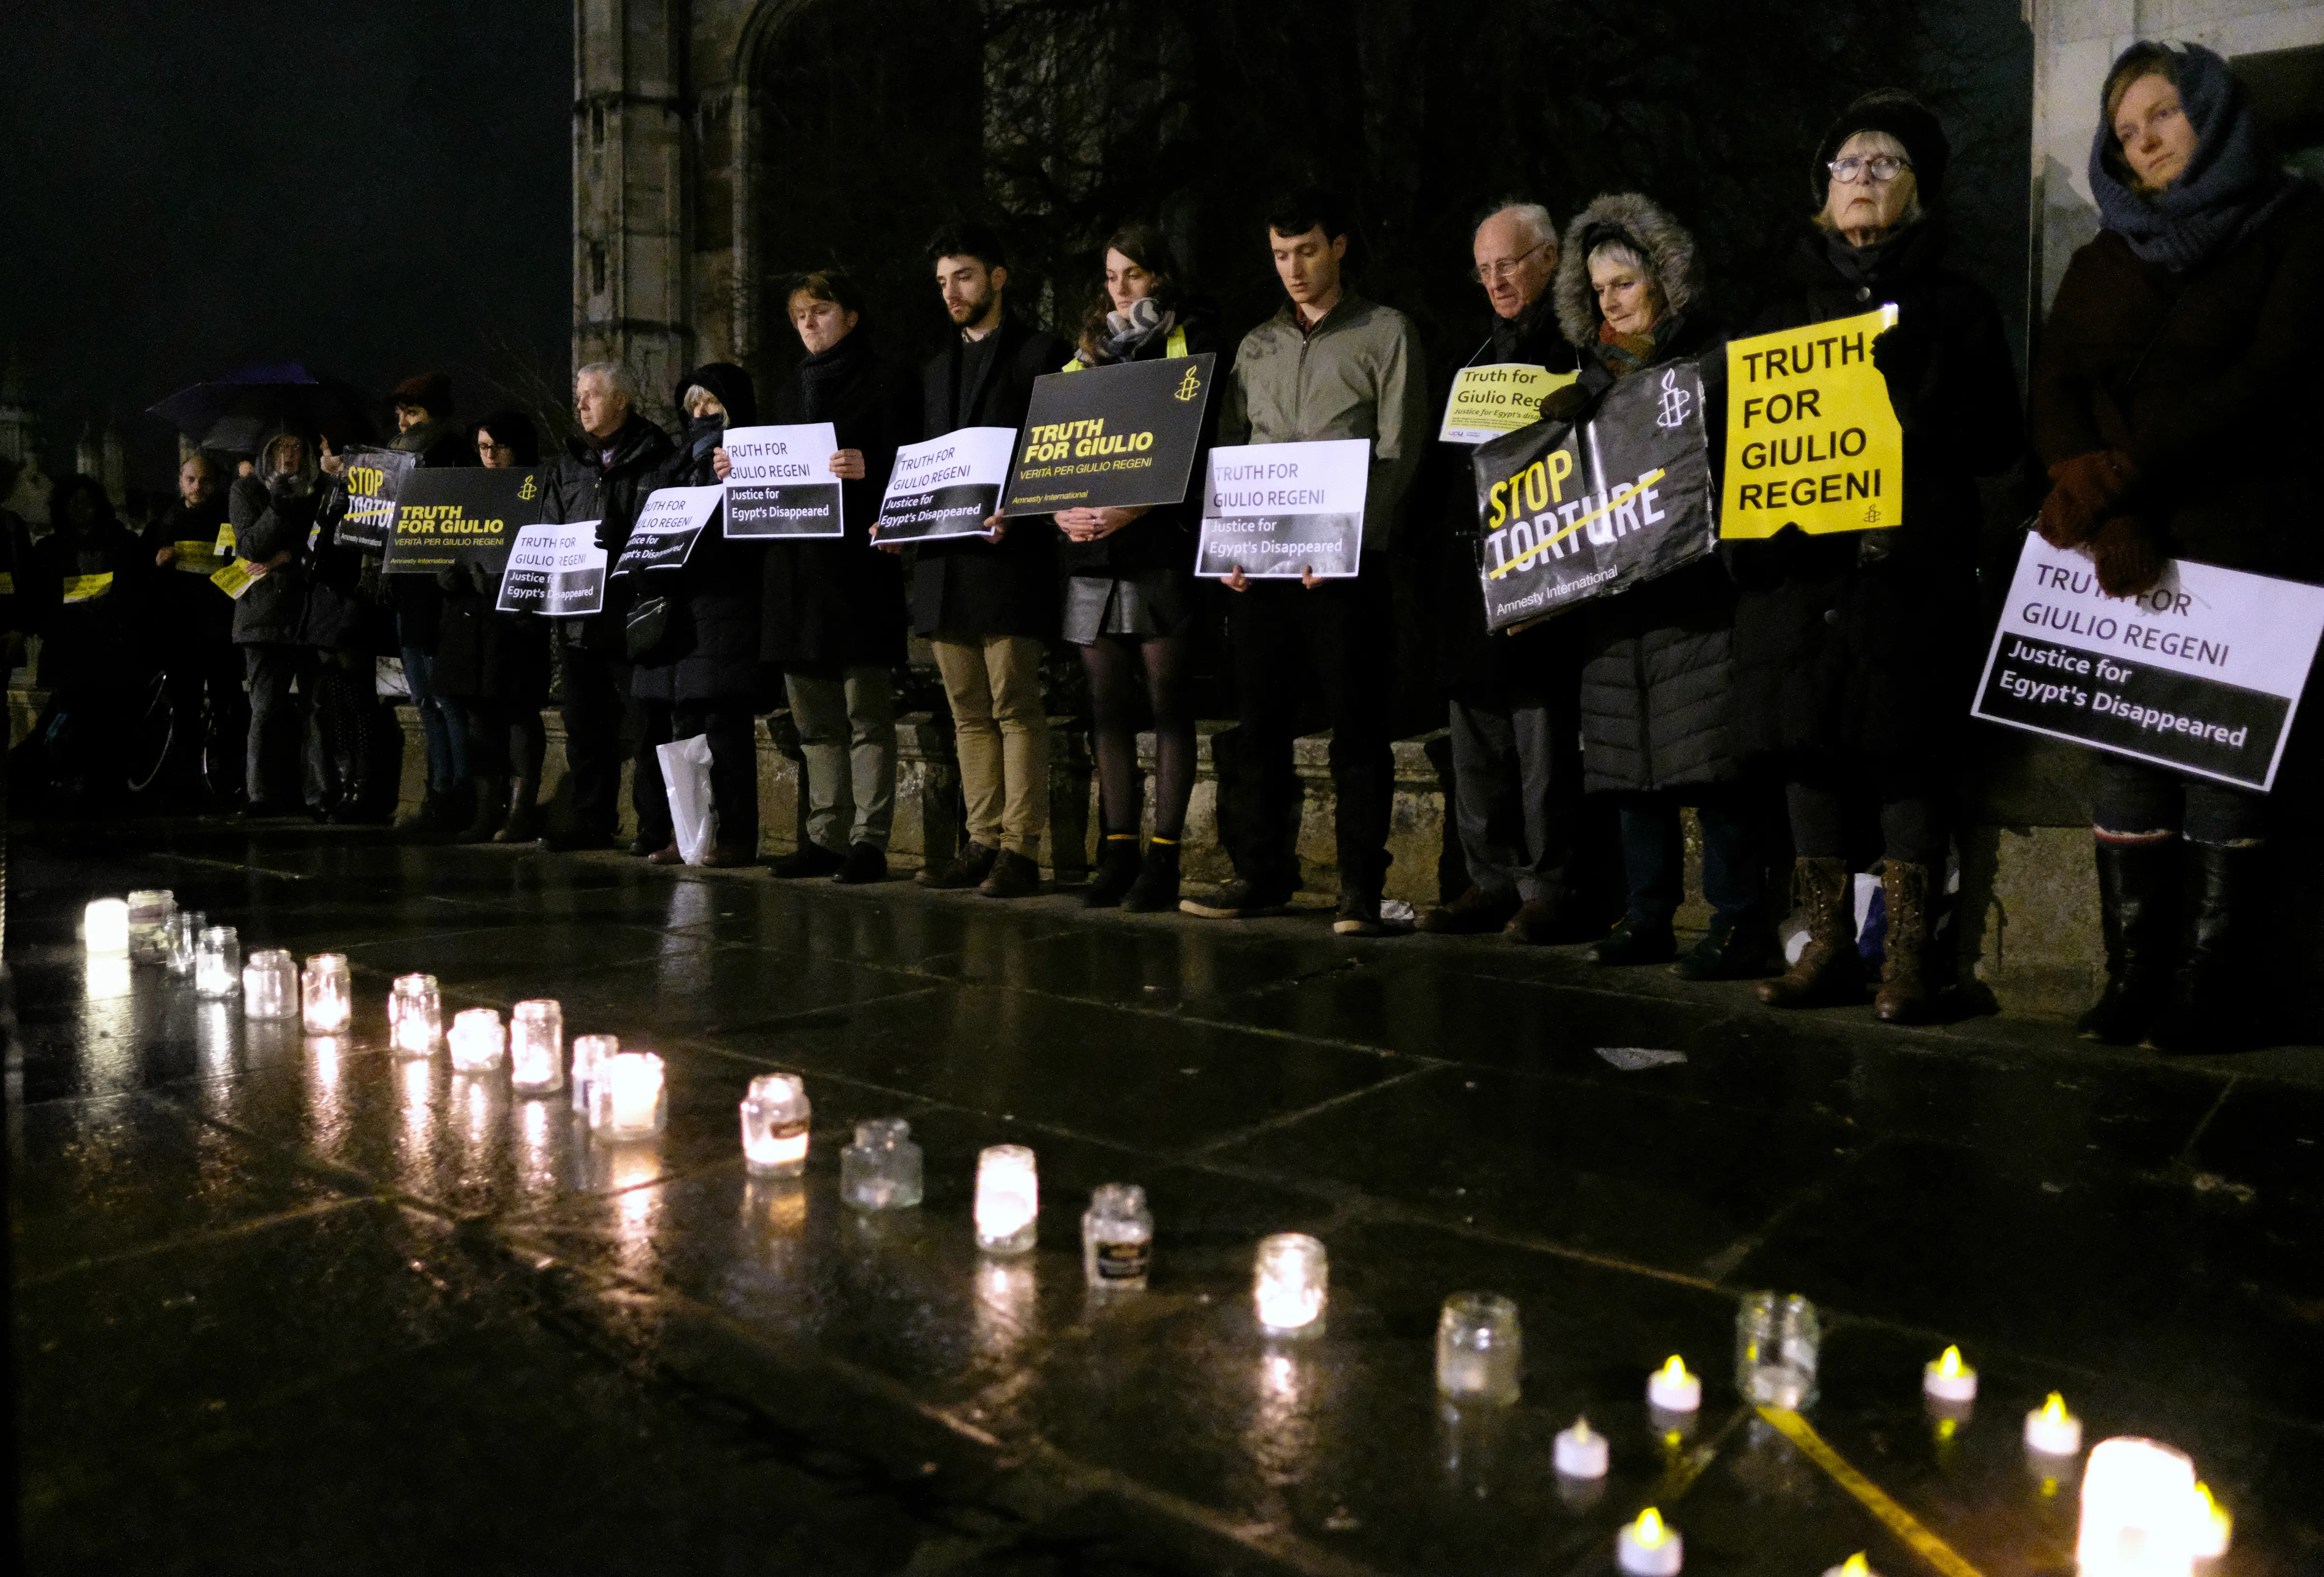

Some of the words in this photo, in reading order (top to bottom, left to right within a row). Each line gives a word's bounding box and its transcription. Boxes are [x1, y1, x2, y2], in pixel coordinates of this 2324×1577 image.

[1743, 332, 1864, 382] TRUTH
[1465, 369, 1507, 382] Truth
[1512, 369, 1537, 384] for
[1458, 390, 1506, 404] Giulio
[1512, 393, 1543, 411] Reg
[1744, 389, 1821, 429] FOR
[1494, 410, 1521, 418] Egypt's
[1031, 418, 1104, 444] TRUTH
[727, 444, 762, 457] TRUTH
[765, 443, 788, 455] FOR
[1024, 442, 1070, 463] FOR
[1075, 431, 1153, 457] GIULIO
[1741, 427, 1867, 470] GIULIO
[901, 453, 934, 471] TRUTH
[935, 447, 955, 463] FOR
[1020, 465, 1051, 480] VERITÀ
[1054, 465, 1074, 476] PER
[1076, 462, 1111, 474] GIULIO
[1113, 457, 1152, 470] REGENI
[730, 466, 766, 479] GIULIO
[769, 463, 810, 478] REGENI
[894, 474, 930, 490] GIULIO
[931, 465, 970, 484] REGENI
[1215, 464, 1263, 481] TRUTH
[1268, 463, 1298, 479] FOR
[347, 466, 383, 497] STOP
[1489, 449, 1572, 528] STOP
[1739, 469, 1881, 510] REGENI
[731, 488, 764, 500] Justice
[765, 488, 779, 499] for
[886, 497, 918, 509] Justice
[920, 494, 933, 504] for
[1012, 496, 1043, 504] Amnesty
[1044, 491, 1088, 501] International
[1214, 492, 1263, 508] GIULIO
[1268, 489, 1325, 506] REGENI
[346, 495, 396, 528] TORTU
[400, 506, 462, 519] TRUTH
[644, 501, 666, 512] RUTH
[666, 500, 686, 510] FOR
[732, 507, 767, 521] Egypt's
[769, 504, 829, 520] Disappeared
[880, 513, 916, 527] Egypt's
[918, 503, 981, 521] Disappeared
[397, 520, 435, 533] FOR
[441, 519, 503, 533] GIULIO
[659, 516, 692, 528] REGENI
[1211, 519, 1255, 532] Justice
[1258, 518, 1277, 531] for
[1489, 468, 1665, 580] TORTURE
[395, 537, 422, 546] VERITÀ
[521, 537, 557, 548] TRUTH
[559, 537, 576, 548] FOR
[646, 535, 659, 544] for
[1210, 541, 1257, 557] Egypt's
[1261, 538, 1343, 556] Disappeared
[516, 554, 554, 566] GIULIO
[559, 553, 586, 566] REGENI
[510, 572, 545, 583] Justice
[2037, 564, 2125, 602] TRU
[507, 586, 545, 599] Egypt's
[547, 585, 593, 600] Dsappeared
[1497, 589, 1543, 616] Amnesty
[1547, 565, 1618, 600] International
[2022, 602, 2117, 640] GIULIO
[2123, 623, 2229, 667] REGENI
[2008, 640, 2090, 674] Justice
[2095, 659, 2133, 684] for
[1999, 669, 2088, 706] Egypt's
[2092, 692, 2248, 748] Disappeared
